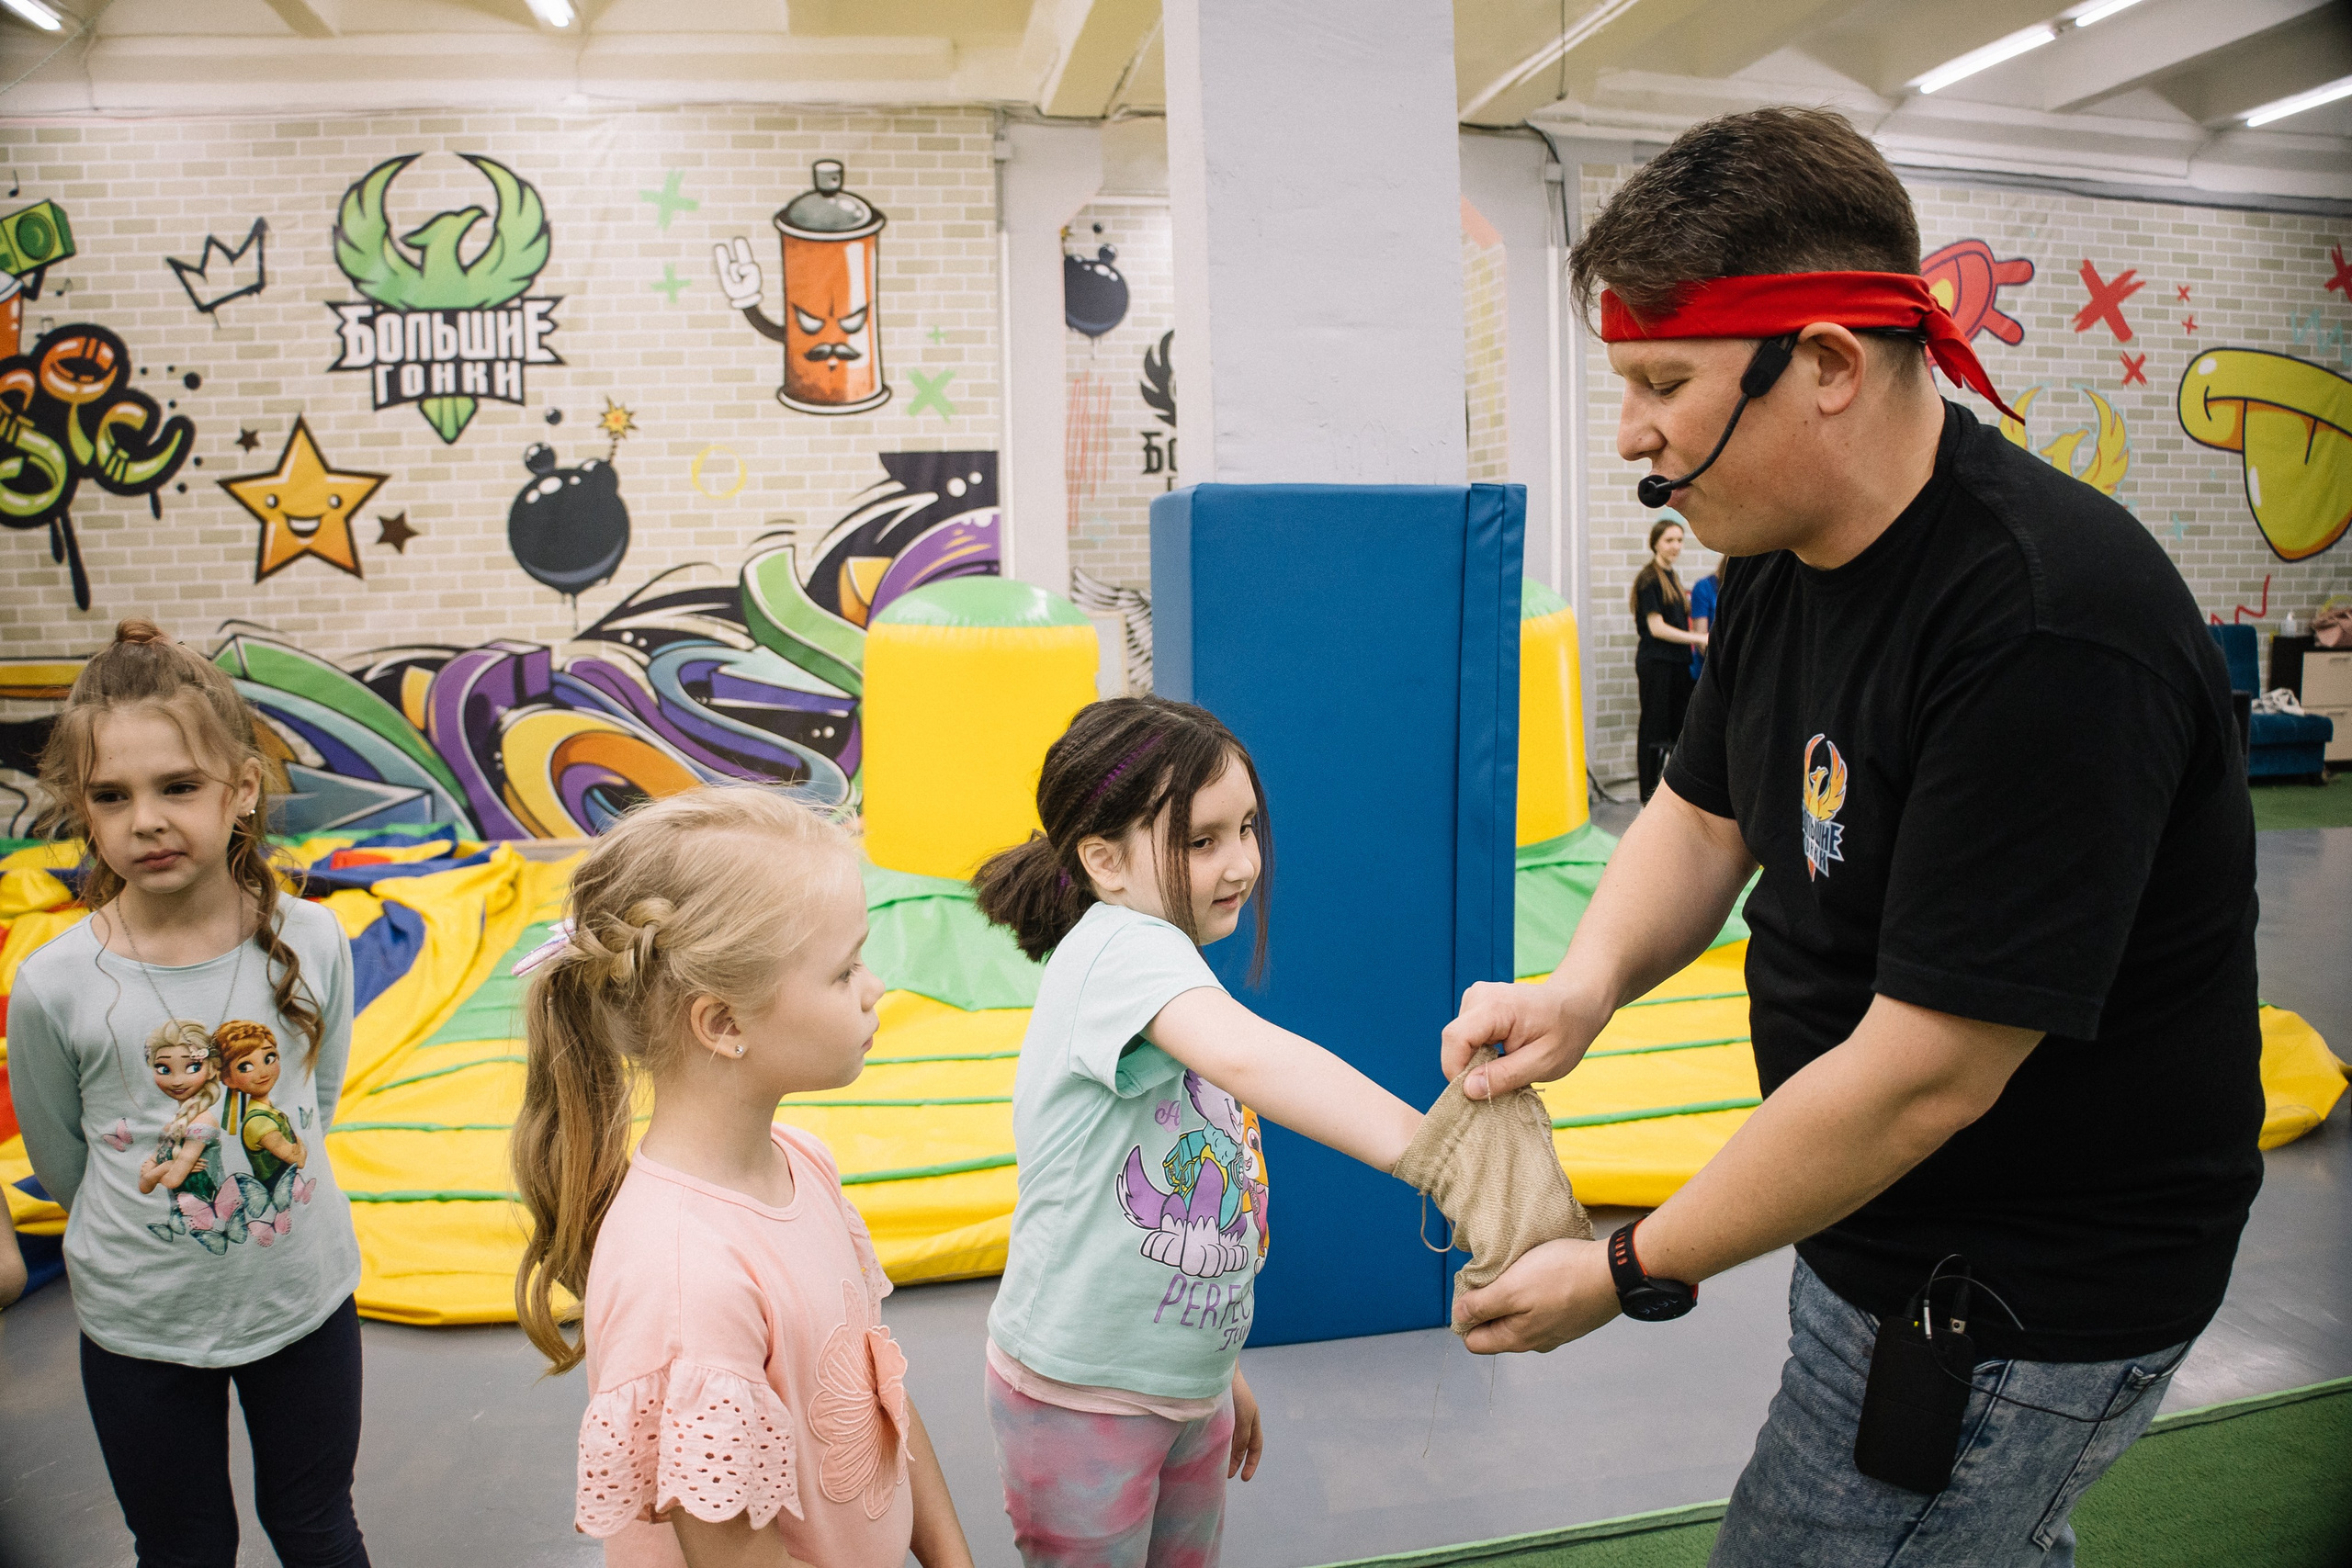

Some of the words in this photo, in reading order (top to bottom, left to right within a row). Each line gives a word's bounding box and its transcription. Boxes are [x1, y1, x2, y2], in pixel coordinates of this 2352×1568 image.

[334, 299, 559, 369] БОЛЬШИЕ
[373, 360, 523, 406] ГОНКИ
[1153, 1273, 1254, 1329] PERFEC
